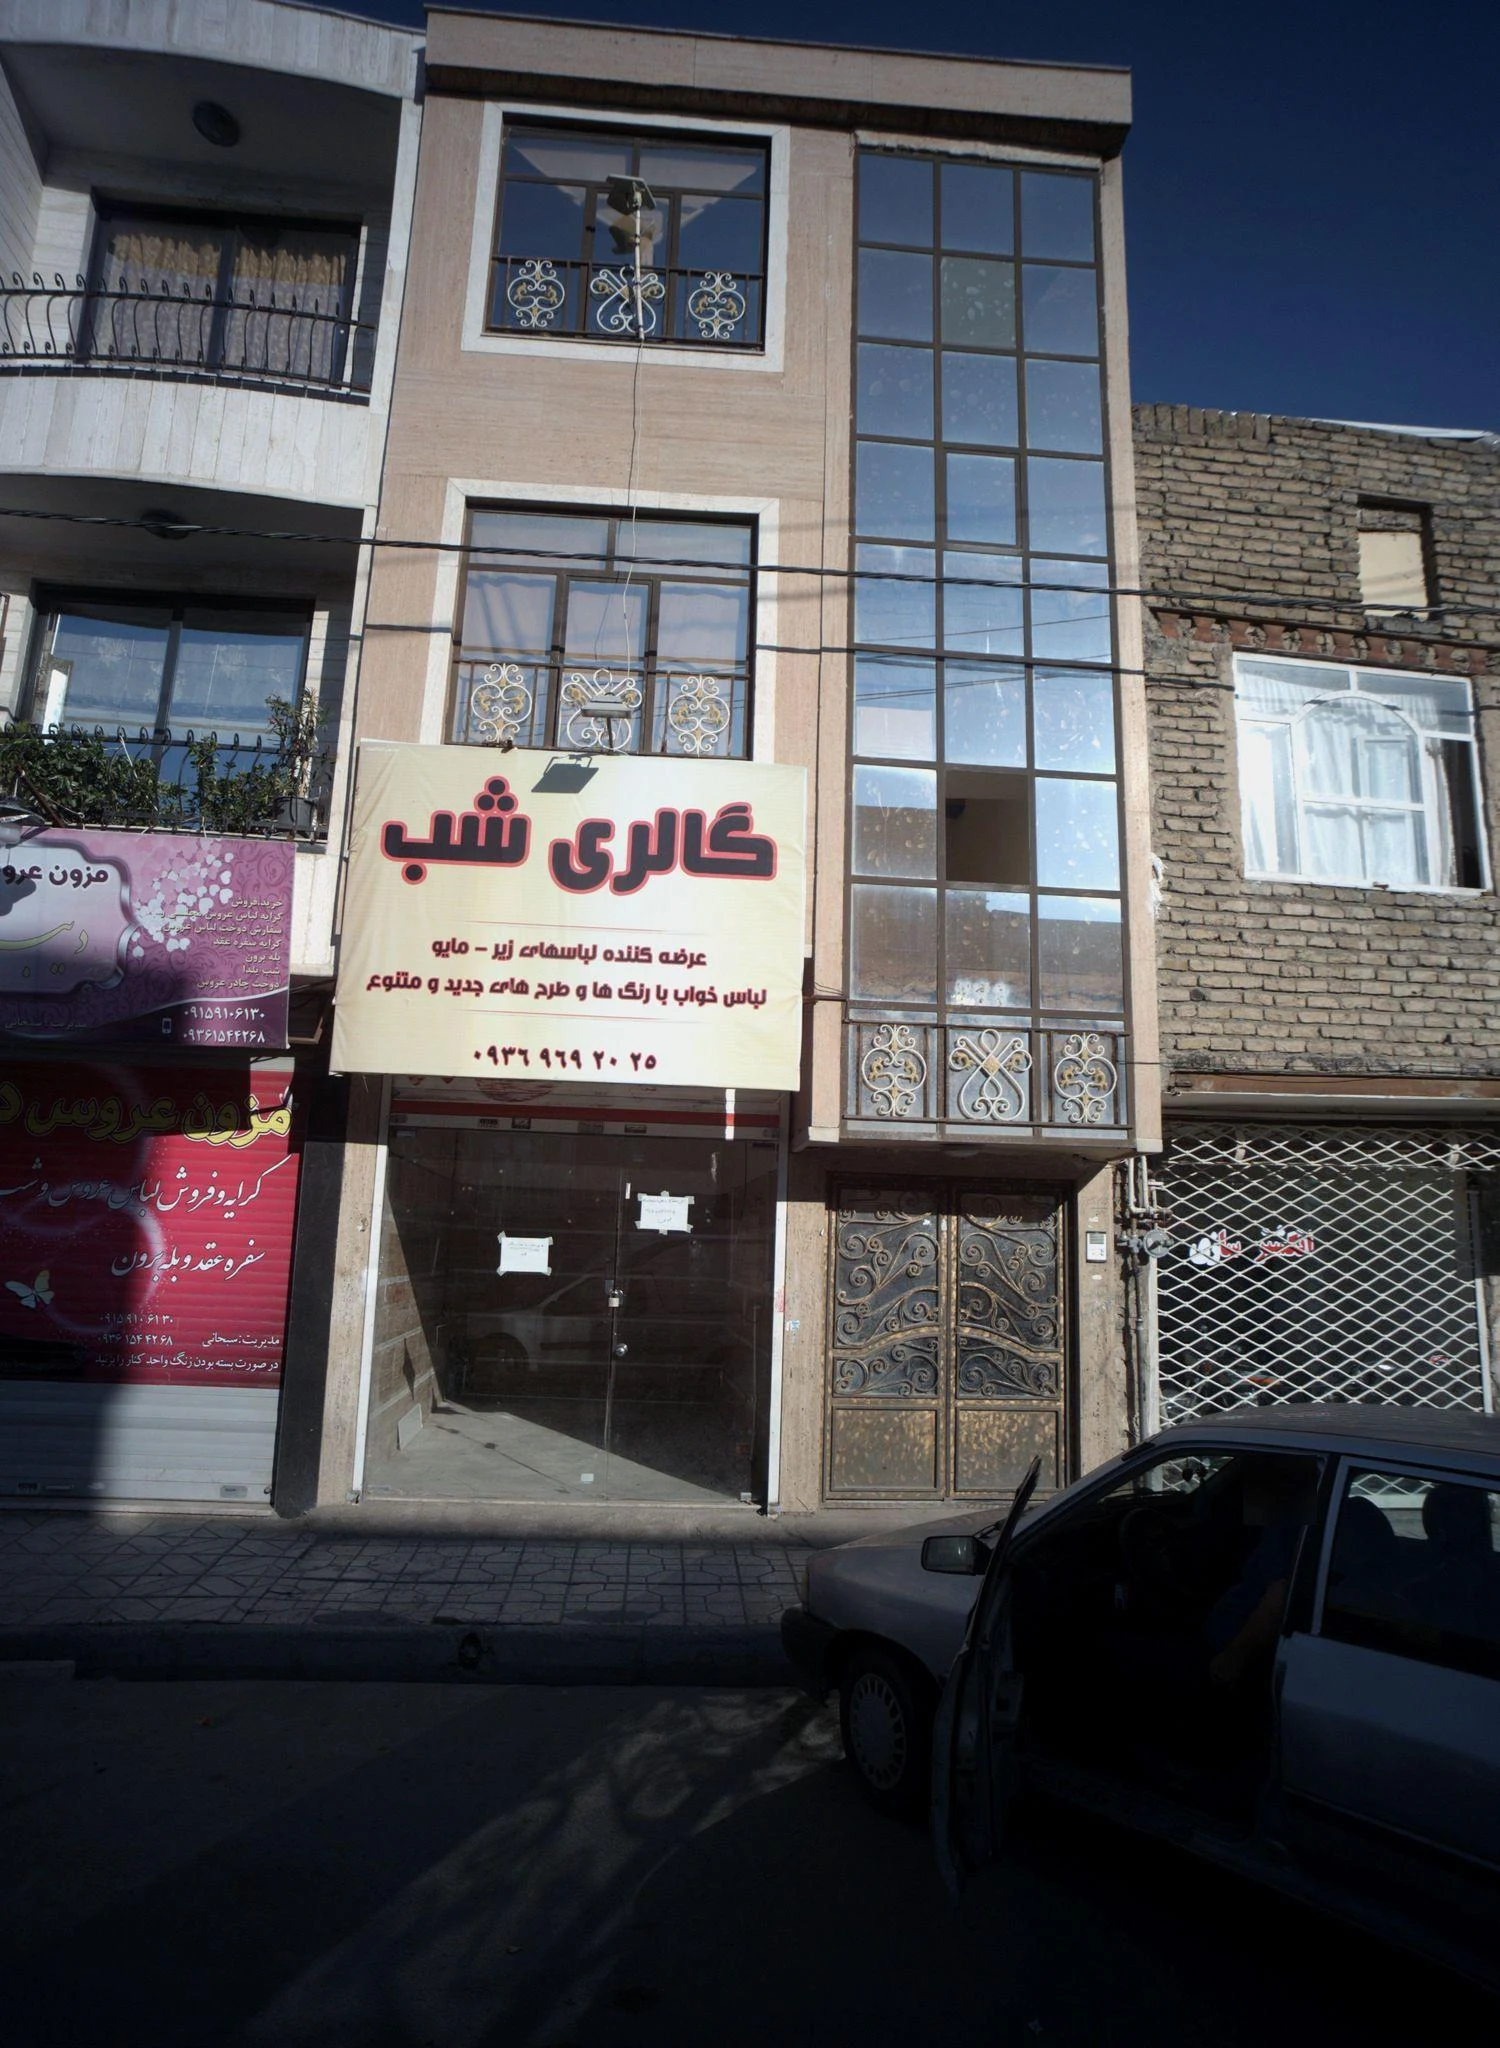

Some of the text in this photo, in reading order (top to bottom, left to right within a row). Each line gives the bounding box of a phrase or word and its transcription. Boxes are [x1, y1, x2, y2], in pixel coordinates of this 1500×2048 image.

[381, 775, 777, 896] گالری شب
[49, 865, 109, 889] مزون
[235, 911, 258, 921] لباس
[195, 922, 217, 933] لباس
[219, 923, 247, 934] دوخت
[259, 939, 282, 949] کرایه
[431, 935, 469, 959] مایو
[491, 939, 514, 960] زیر
[519, 942, 597, 965] لباسهای
[602, 946, 652, 964] کننده
[658, 948, 707, 966] عرضه
[366, 969, 767, 1009] لباس خواب با رنگ ها و طرح های جدید و متنوع
[25, 1096, 180, 1144] عروس
[182, 1092, 293, 1149] مزون
[48, 1179, 111, 1208] عروس
[156, 1166, 217, 1213] فروش
[214, 1184, 225, 1205] و
[223, 1153, 293, 1218] کرایه
[107, 1179, 161, 1217] لباس
[110, 1239, 266, 1283] سفره عقد و بله برون
[146, 1354, 169, 1367] واحد
[170, 1351, 194, 1368] زنگ
[193, 1357, 215, 1369] بودن
[215, 1358, 234, 1370] بسته
[235, 1358, 267, 1372] صورت
[268, 1360, 279, 1372] در
